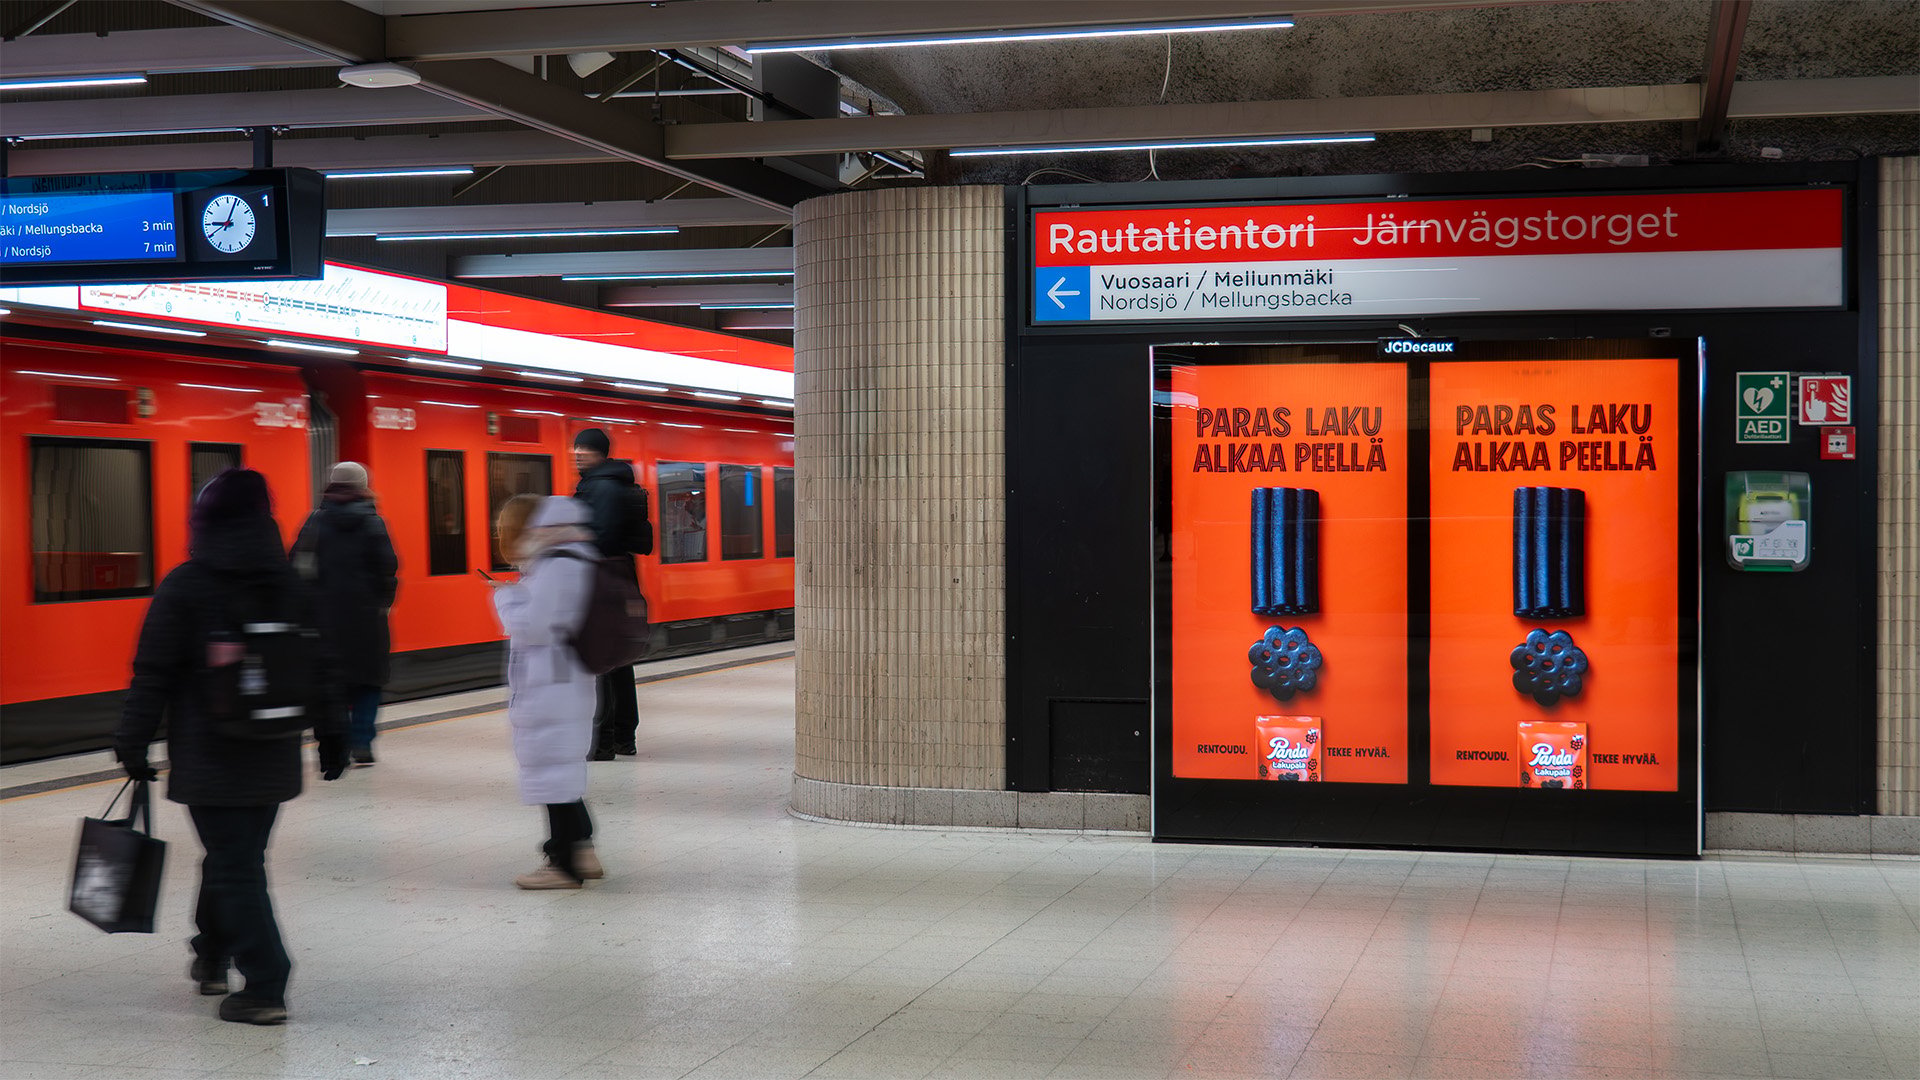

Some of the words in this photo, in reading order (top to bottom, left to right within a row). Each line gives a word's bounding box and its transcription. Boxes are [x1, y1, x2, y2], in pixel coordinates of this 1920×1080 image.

[262, 194, 269, 207] 1
[9, 203, 49, 216] Nordsjö
[25, 222, 103, 237] Mellungsbacka
[142, 221, 150, 232] 3
[153, 220, 173, 231] min
[1050, 215, 1315, 254] Rautatientori
[1352, 206, 1678, 248] Järnvägstorget
[11, 245, 51, 258] Nordsjö
[144, 243, 150, 253] 7
[154, 242, 174, 252] min
[1101, 271, 1190, 290] Vuosaari
[1196, 270, 1208, 293] /
[1215, 268, 1333, 288] Mellunmäki
[1100, 293, 1178, 312] Nordsjö
[1184, 291, 1195, 311] /
[1202, 289, 1352, 310] Mellungsbacka
[1384, 341, 1453, 353] JCDecaux
[1196, 406, 1291, 438] PARAS
[1305, 406, 1382, 436] LAKU
[1456, 404, 1556, 436] PARAS
[1571, 403, 1652, 434] LAKU
[1744, 420, 1782, 434] AED
[1193, 442, 1287, 472] ALKAA
[1294, 437, 1387, 472] PEELLÄ
[1452, 441, 1551, 472] ALKAA
[1559, 435, 1657, 471] PEELLÄ
[1197, 744, 1248, 755] RENTOUDU.
[1266, 737, 1309, 760] Panda
[1327, 747, 1352, 757] TEKEE
[1355, 746, 1390, 758] HYVÄÄ.
[1456, 750, 1510, 761] RENTOUDU.
[1528, 743, 1574, 767] Panda
[1272, 761, 1307, 771] Lakupala
[1593, 753, 1619, 764] TEKEE
[1622, 752, 1660, 765] HYVÄÄ.
[1534, 768, 1571, 778] Lakupala
